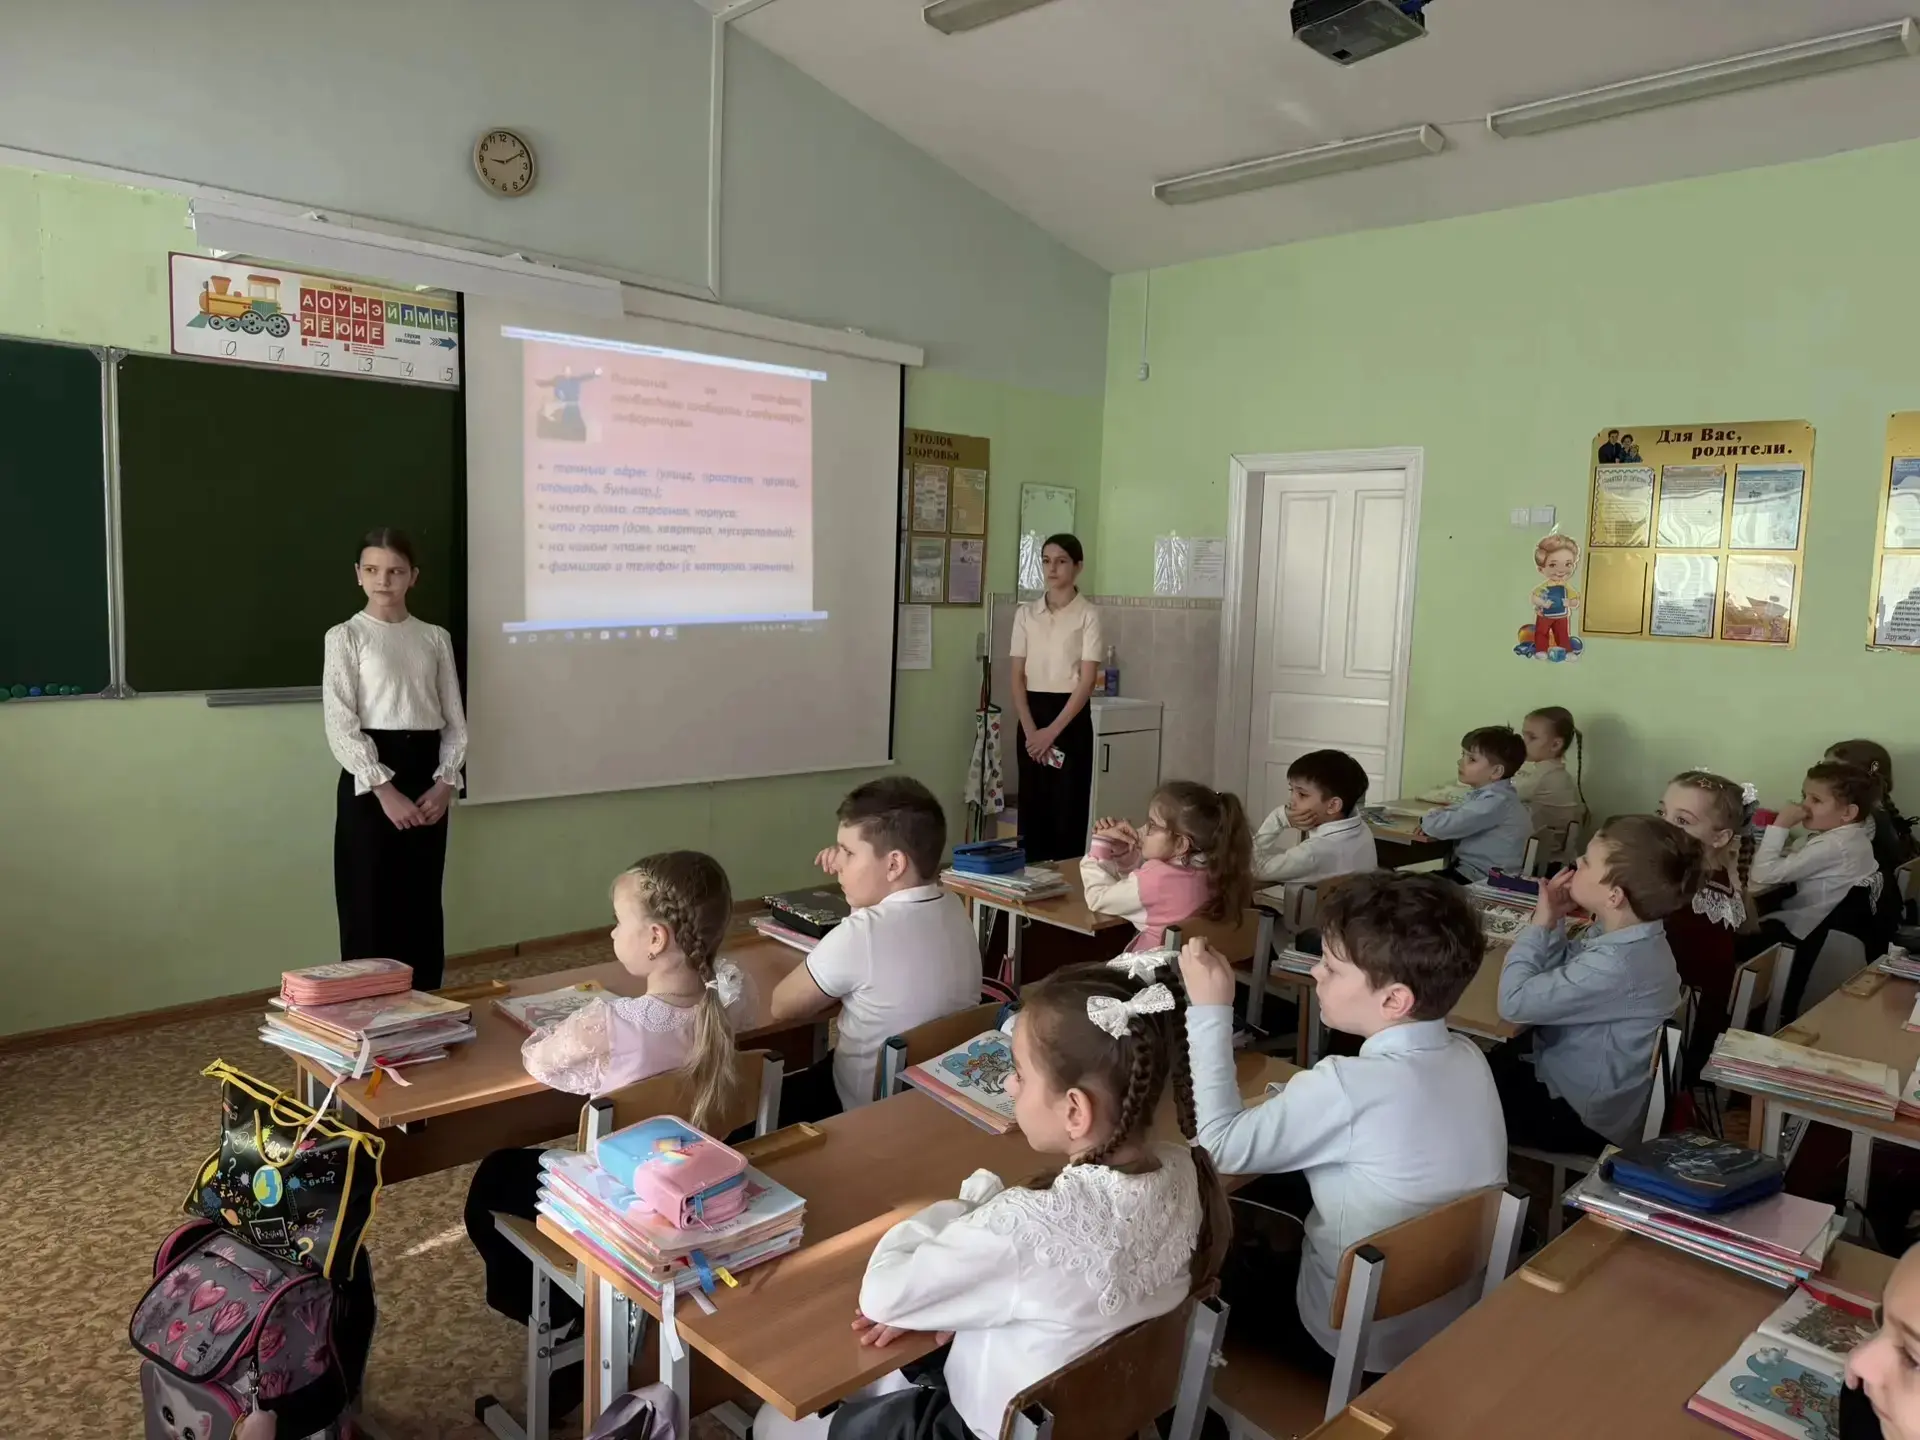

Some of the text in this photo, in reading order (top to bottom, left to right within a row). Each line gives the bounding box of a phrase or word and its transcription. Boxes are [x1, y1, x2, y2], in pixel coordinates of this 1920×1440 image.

[489, 135, 496, 144] 11
[499, 134, 507, 142] 12
[481, 143, 489, 151] 10
[479, 154, 485, 163] 9
[523, 162, 528, 170] 3
[482, 167, 488, 176] 8
[520, 174, 525, 182] 4
[502, 183, 507, 191] 6
[513, 181, 518, 189] 5
[302, 294, 314, 308] А
[319, 296, 332, 310] О
[338, 299, 348, 311] У
[353, 302, 367, 316] Ы
[371, 304, 382, 317] Э
[387, 304, 398, 320] Й
[403, 308, 414, 321] Л
[418, 311, 431, 324] М
[434, 314, 445, 326] Н
[303, 317, 381, 340] Я Ё Ю И Е
[226, 341, 237, 356] 0
[320, 352, 330, 367] 2
[363, 357, 374, 372] 3
[405, 363, 413, 377] 4
[445, 367, 454, 381] 5
[913, 432, 953, 448] УГОЛОК
[1655, 428, 1743, 446] Для Вас,
[906, 445, 960, 461] ЗДОРОВЬЯ
[1691, 443, 1793, 460] родители.
[265, 1141, 287, 1163] ABC
